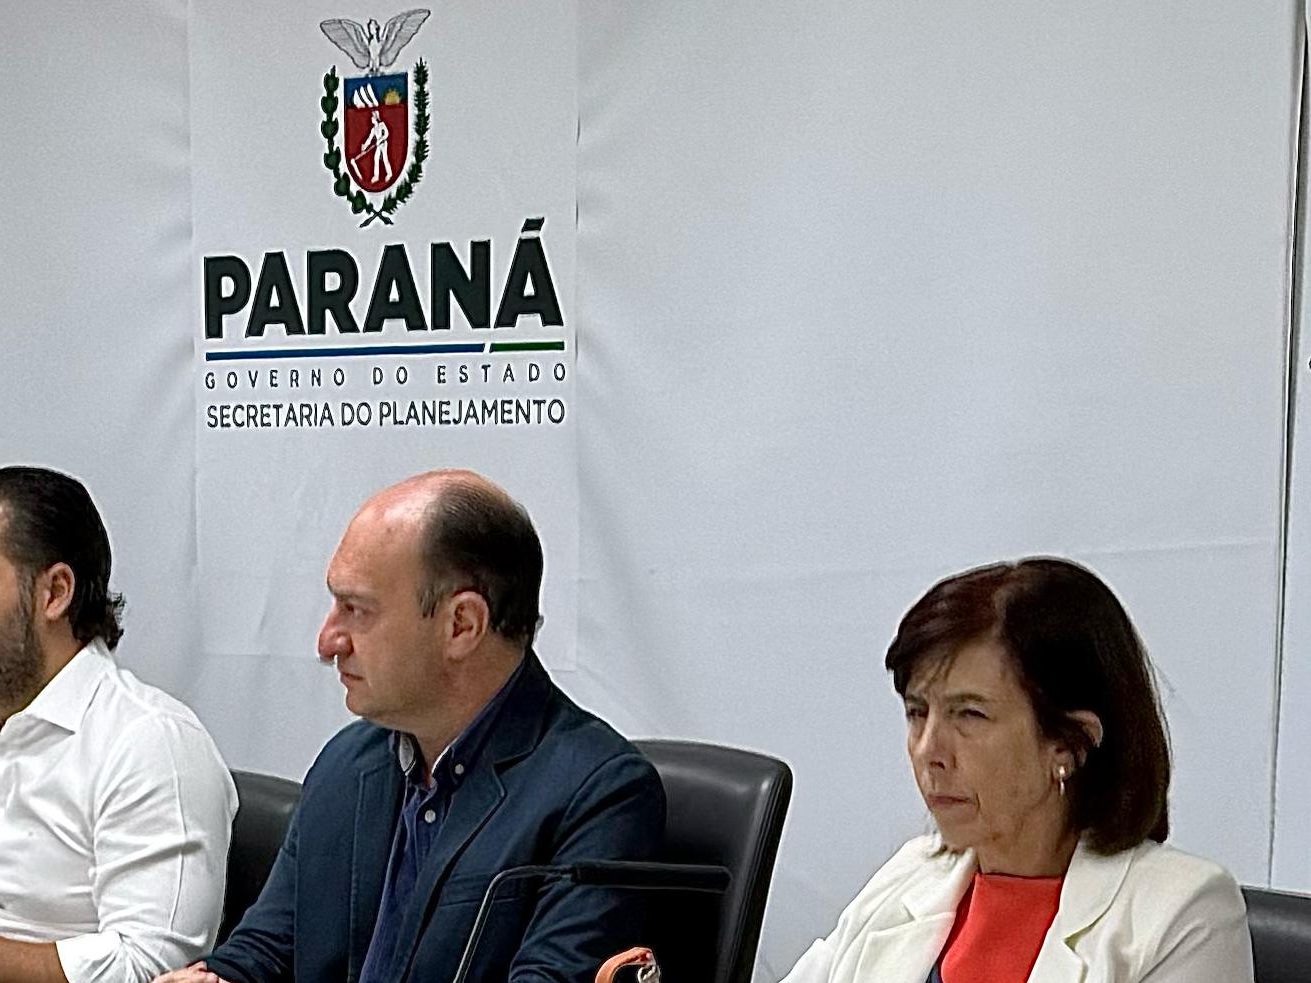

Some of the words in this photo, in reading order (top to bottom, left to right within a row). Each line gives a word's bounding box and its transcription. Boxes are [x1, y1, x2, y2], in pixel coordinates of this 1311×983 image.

[204, 217, 564, 340] PARANÁ
[205, 367, 346, 389] GOVERNO
[373, 366, 408, 386] DO
[438, 362, 567, 385] ESTADO
[206, 402, 335, 429] SECRETARIA
[341, 402, 372, 427] DO
[380, 398, 567, 427] PLANEJAMENTO
